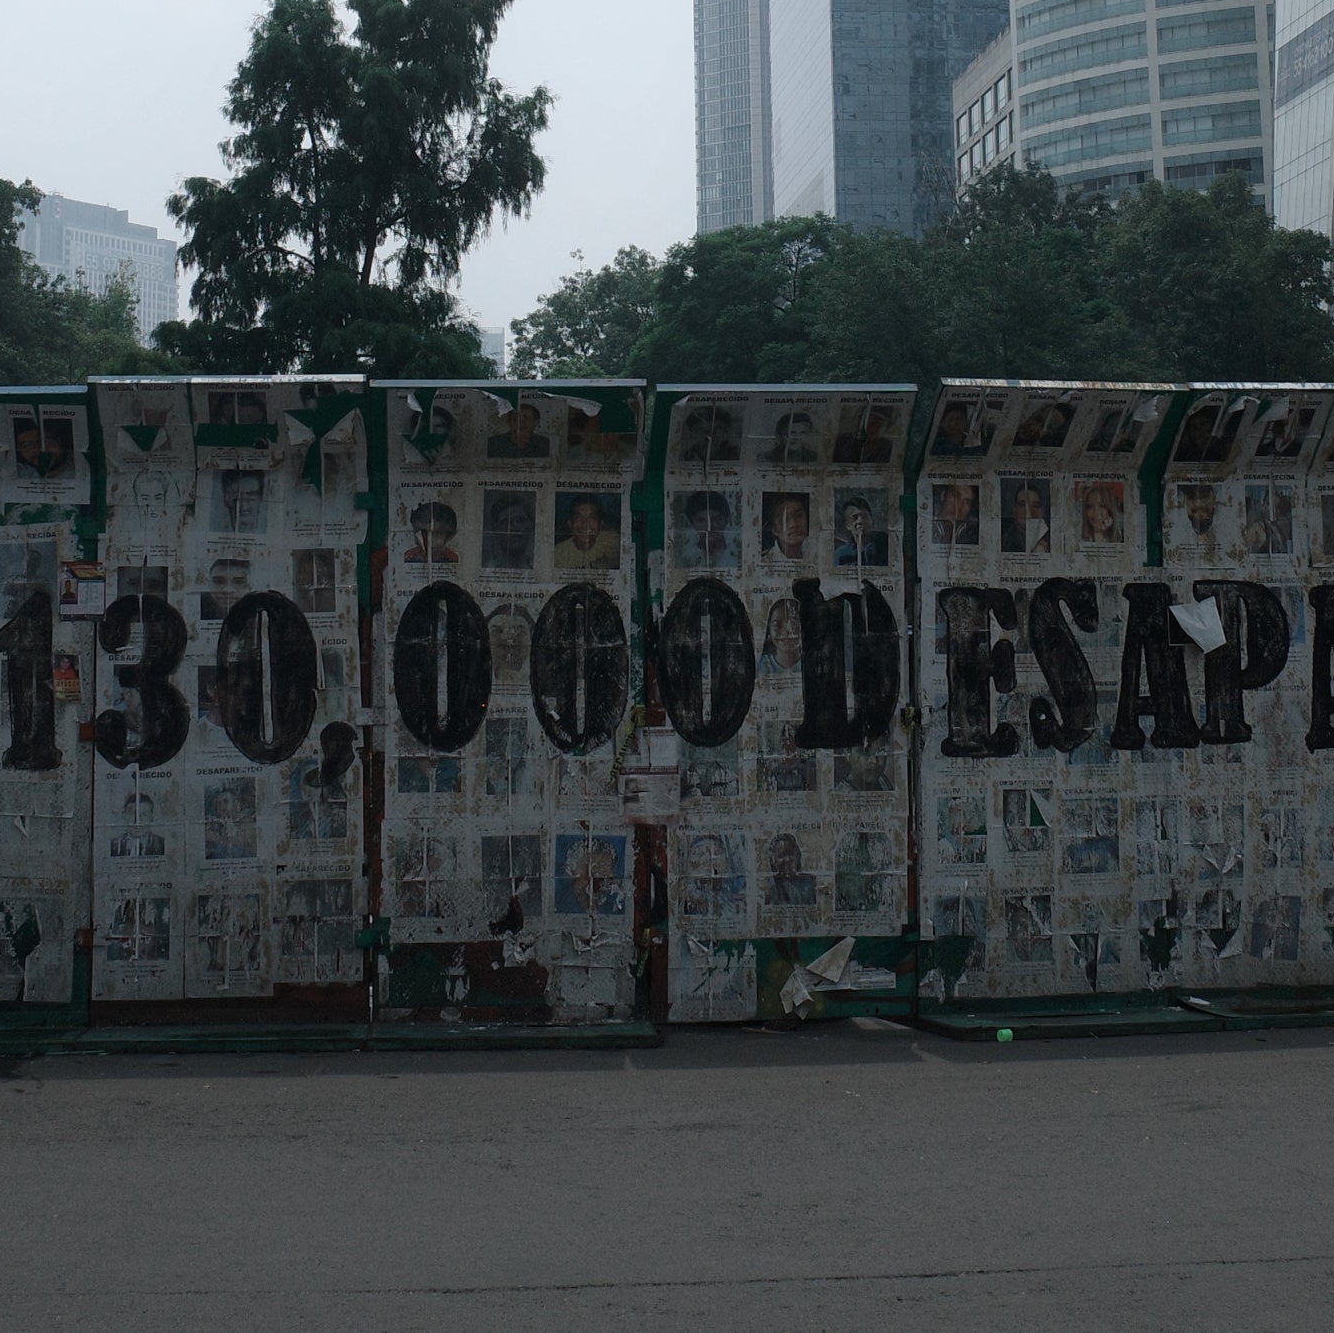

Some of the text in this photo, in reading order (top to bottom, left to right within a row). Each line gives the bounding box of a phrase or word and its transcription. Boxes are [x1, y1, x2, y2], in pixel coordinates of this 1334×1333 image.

[8, 408, 76, 417] DESARECIDO
[556, 481, 622, 490] DESAPARECIDO
[479, 590, 545, 599] DESAPAECIDO
